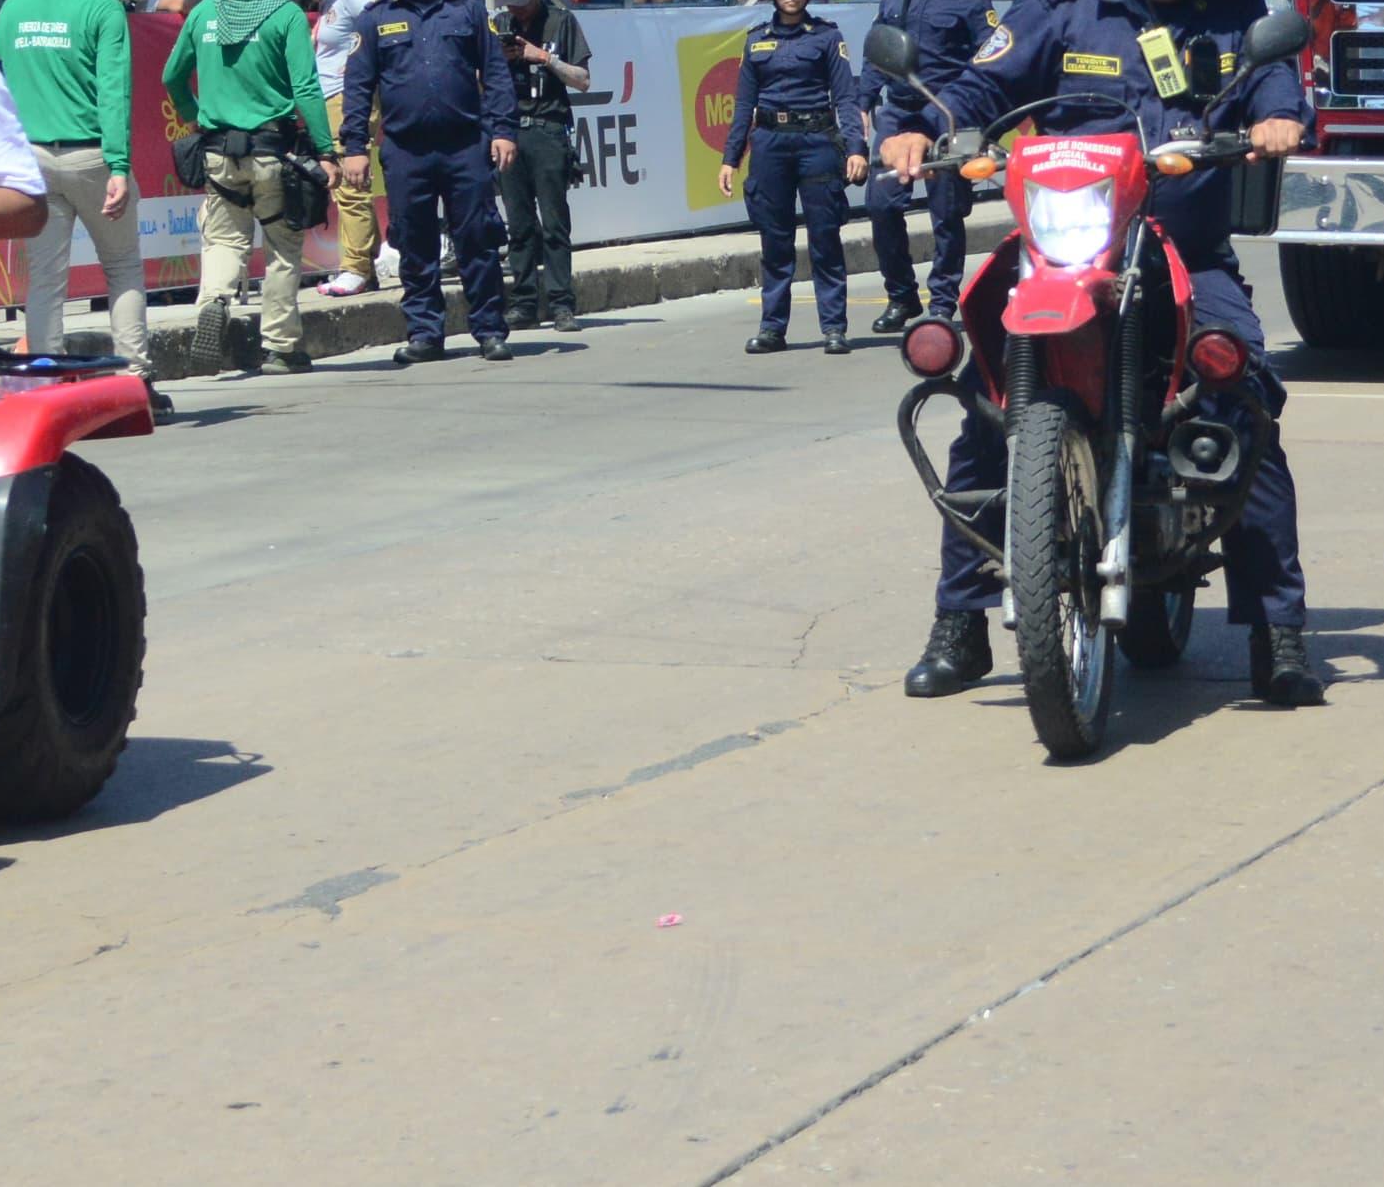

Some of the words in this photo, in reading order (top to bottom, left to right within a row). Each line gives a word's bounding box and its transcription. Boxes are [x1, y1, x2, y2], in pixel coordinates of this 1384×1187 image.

[1022, 142, 1055, 156] CUERPO
[1057, 140, 1069, 151] DE
[1070, 140, 1124, 156] BOMBEROS
[1049, 150, 1088, 161] OFICIAL
[1031, 157, 1107, 174] BARRANQUILLA
